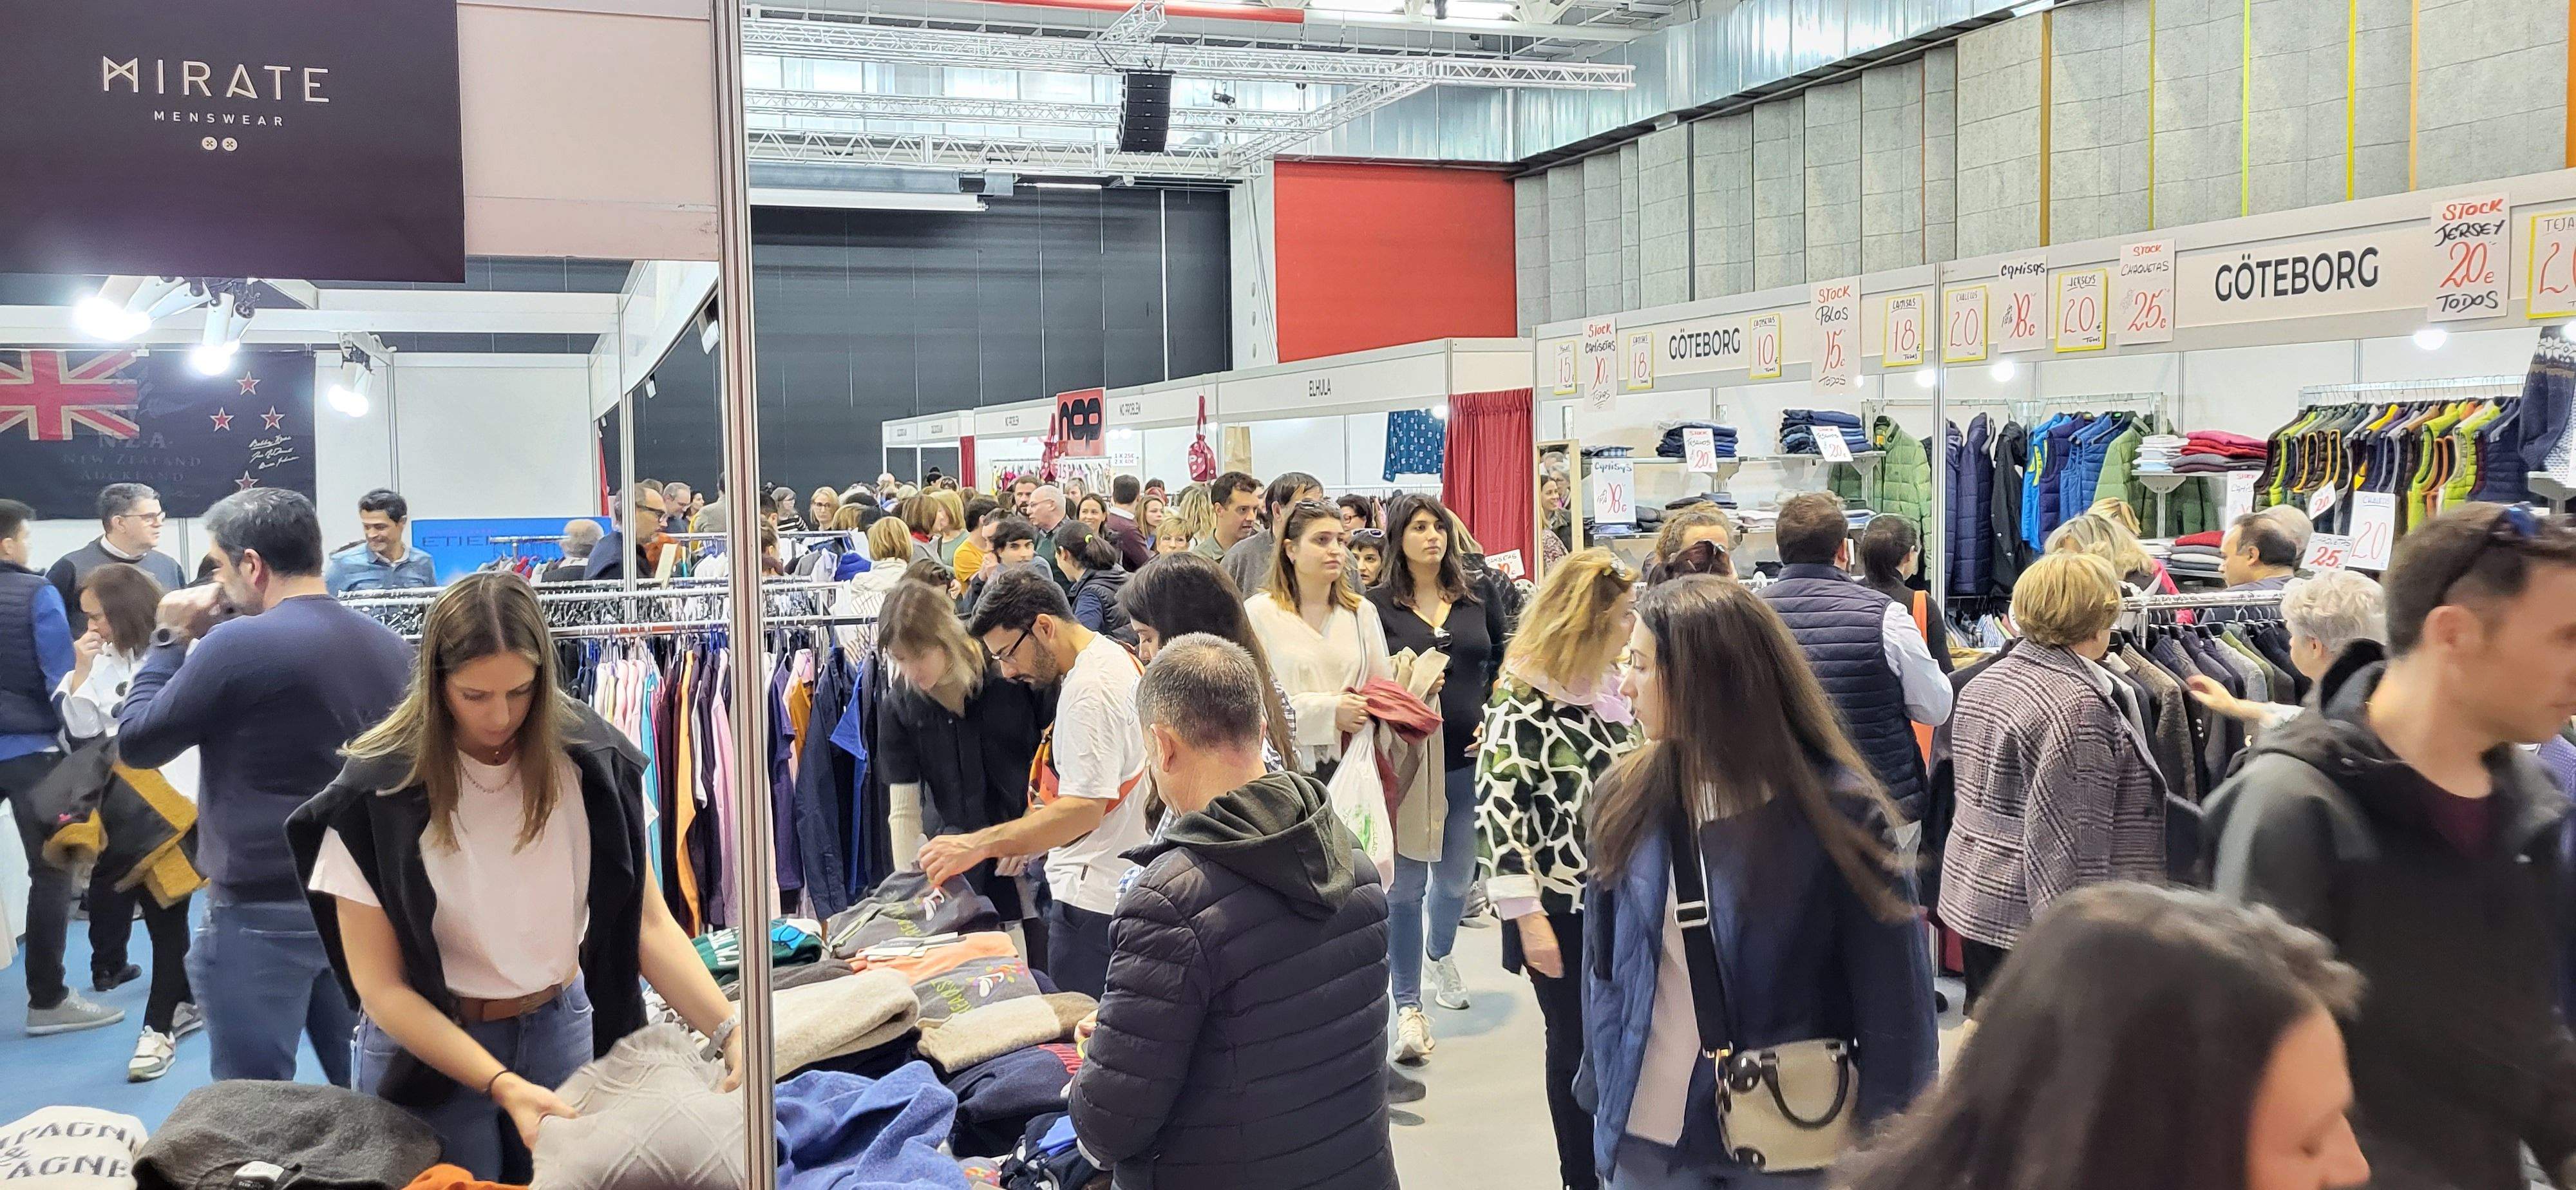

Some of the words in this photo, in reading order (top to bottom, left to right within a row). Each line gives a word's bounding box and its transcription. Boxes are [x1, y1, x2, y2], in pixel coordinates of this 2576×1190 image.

[102, 55, 330, 103] MIRATE
[154, 110, 283, 127] MENSWEAR
[2442, 198, 2504, 221] STOCK
[2434, 219, 2505, 247] JERSEY
[2133, 244, 2162, 257] STOCK
[2121, 260, 2170, 277] CHAQUETAS
[2215, 246, 2379, 302] GÖTEBORG
[2067, 274, 2096, 288] JERSEYS
[1818, 285, 1851, 303] STOCK
[2436, 290, 2499, 313] TODOS
[1892, 298, 1917, 310] CAMISAS
[1588, 323, 1612, 337] STOCK
[1669, 327, 1741, 360] GÖTEBORG
[1309, 378, 1332, 397] ELHULA
